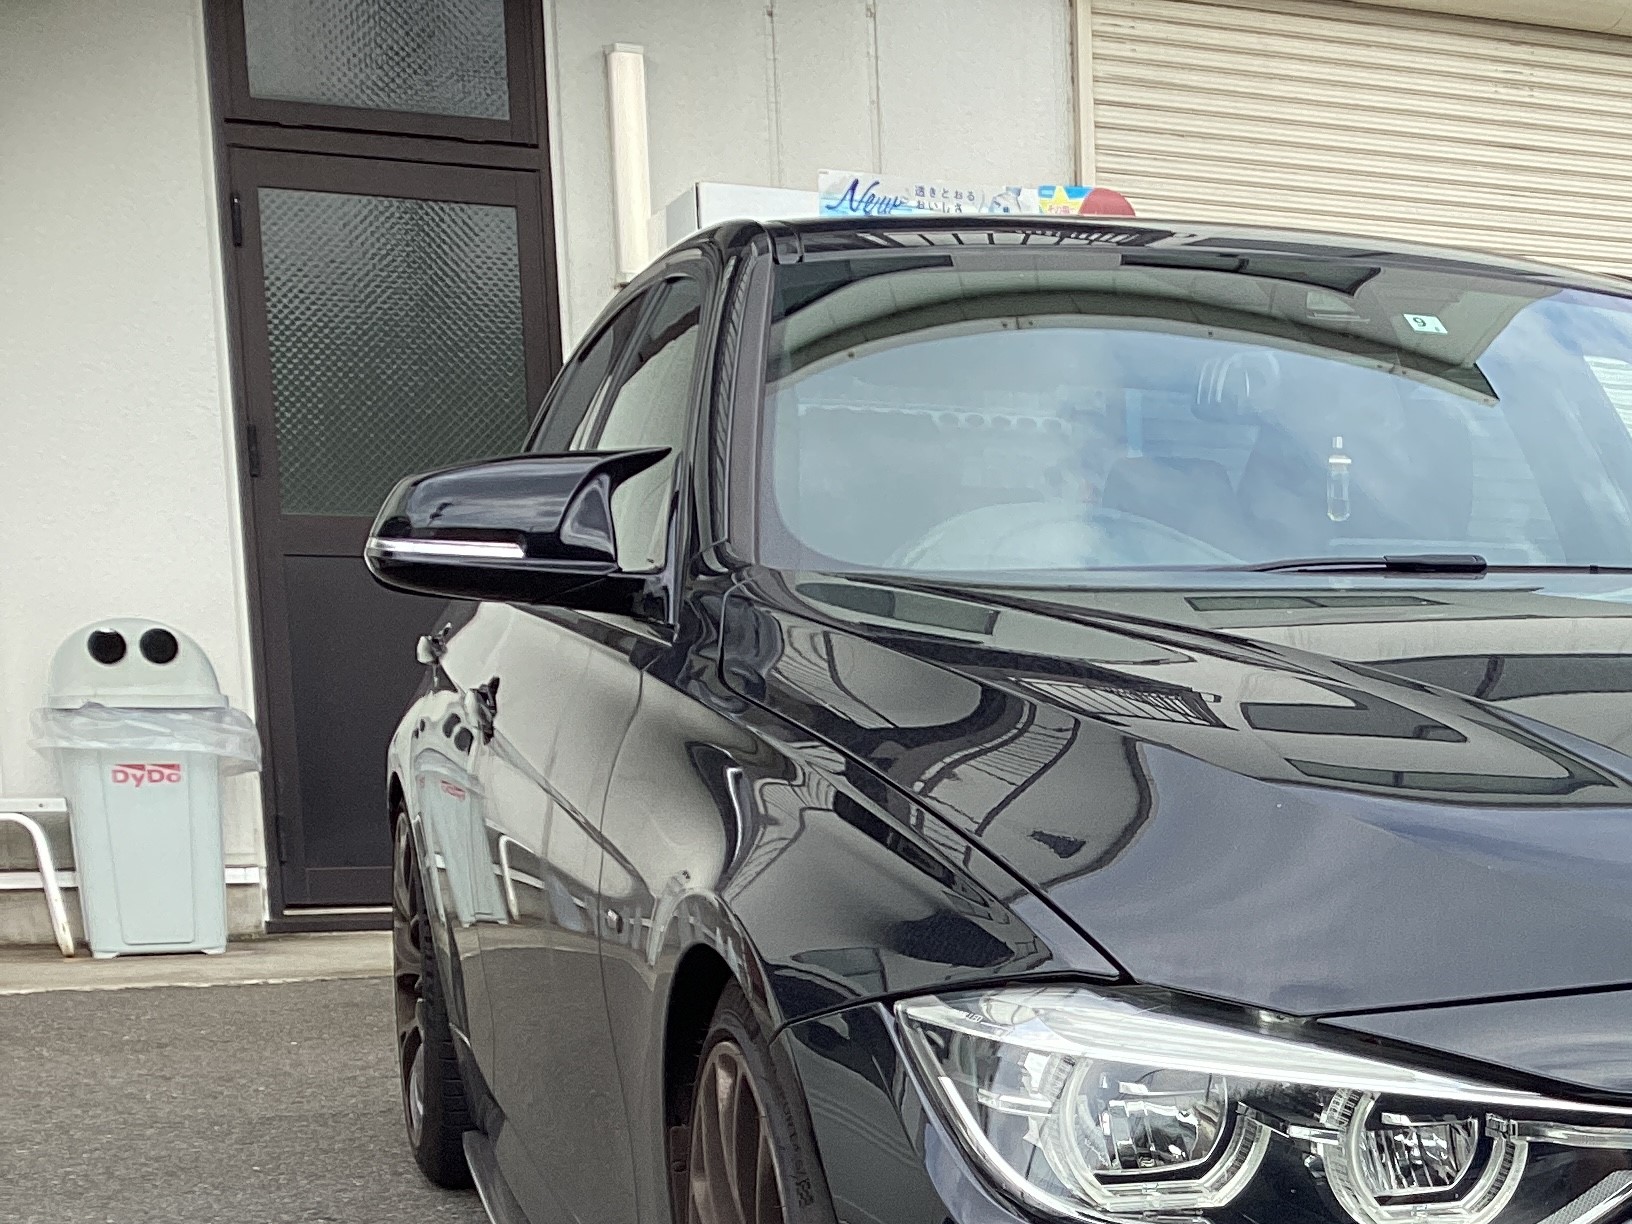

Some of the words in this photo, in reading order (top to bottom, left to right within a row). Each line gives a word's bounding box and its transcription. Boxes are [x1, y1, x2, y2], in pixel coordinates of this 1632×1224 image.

[914, 185, 976, 203] 透きとおる
[915, 200, 963, 214] おいしさ
[111, 767, 182, 788] DyDo
